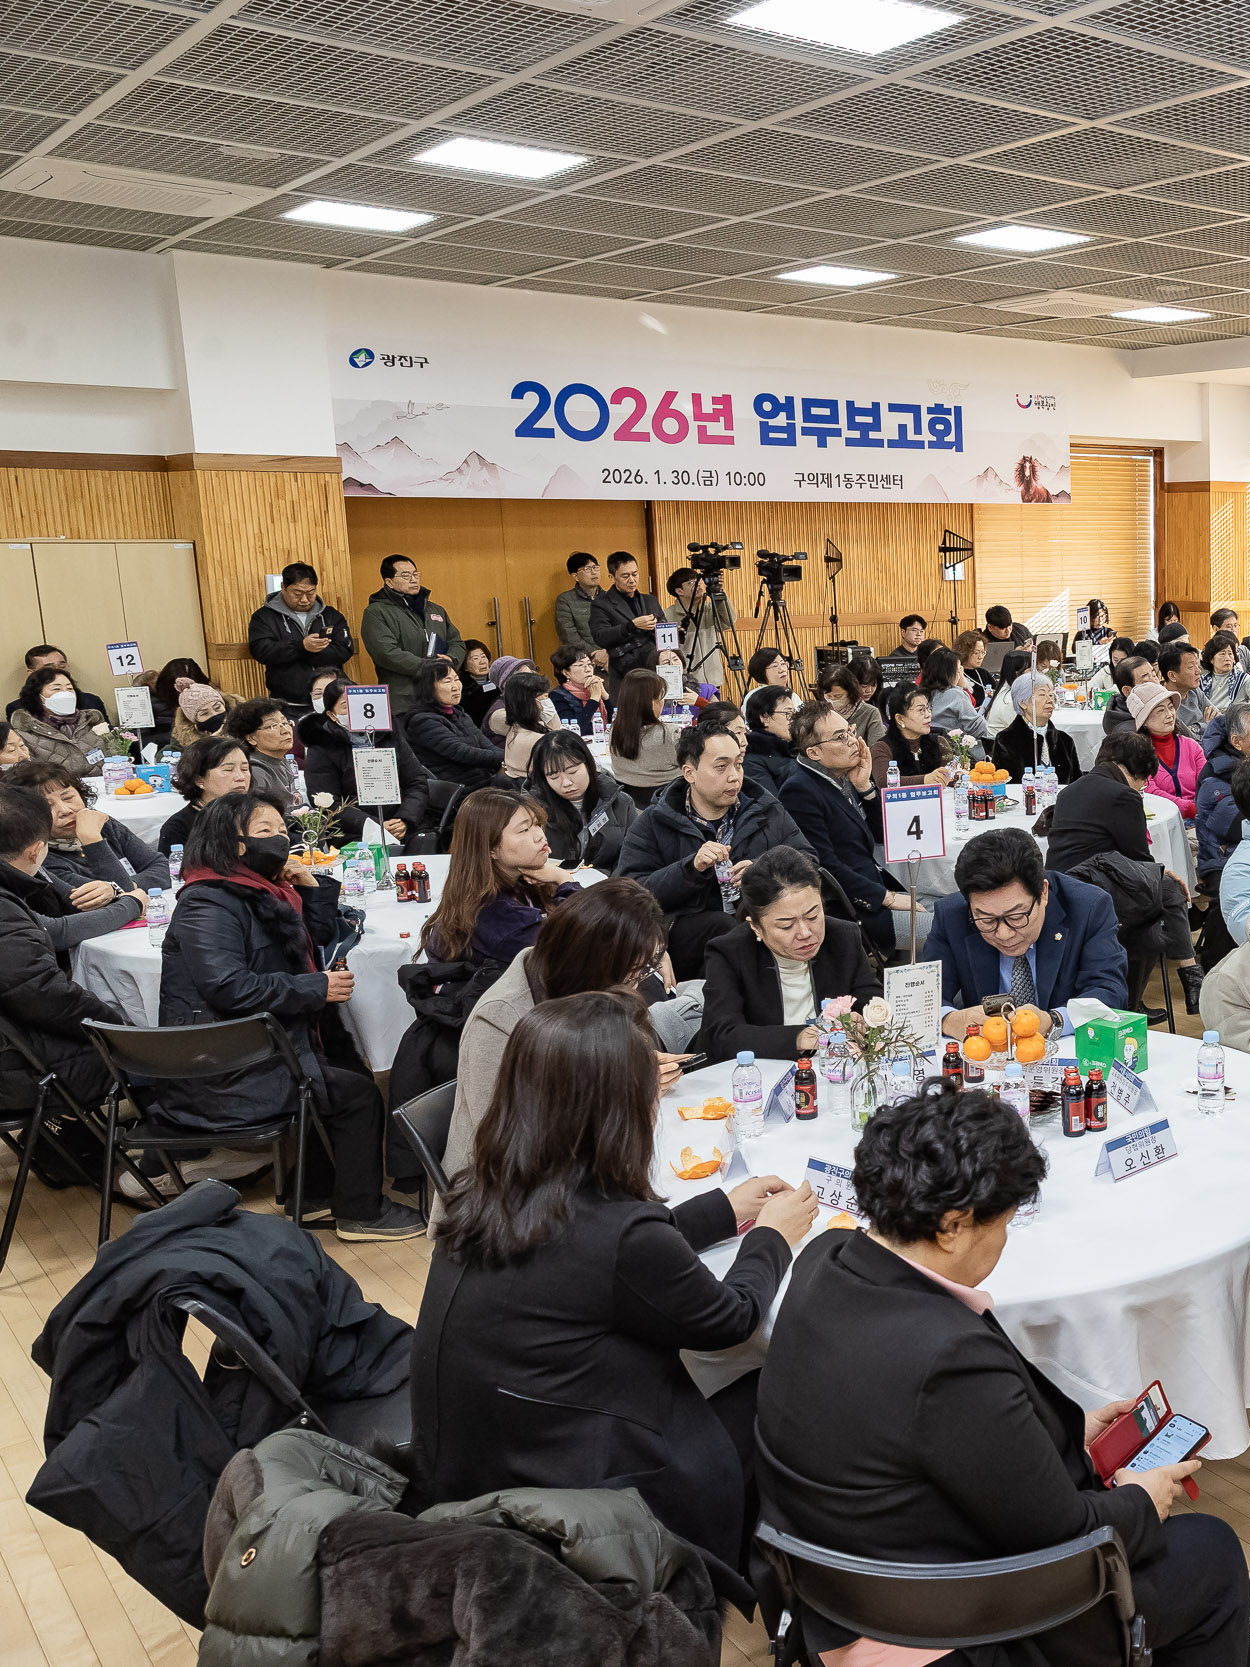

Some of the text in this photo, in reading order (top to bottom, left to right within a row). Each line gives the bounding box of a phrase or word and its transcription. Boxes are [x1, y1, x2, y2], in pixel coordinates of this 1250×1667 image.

[380, 353, 429, 368] 광진구
[511, 380, 964, 452] 2026년 업무보고회
[601, 468, 648, 485] 2026.
[725, 470, 766, 487] 10:00
[1080, 616, 1087, 625] 10
[661, 633, 673, 643] 11
[116, 653, 136, 667] 12
[363, 703, 375, 719] 8
[907, 815, 923, 840] 4
[1125, 1126, 1152, 1143] 국민의힘
[1125, 1136, 1157, 1154] 당협위원장
[1124, 1144, 1166, 1172] 오신환
[816, 1185, 857, 1211] 고상순
